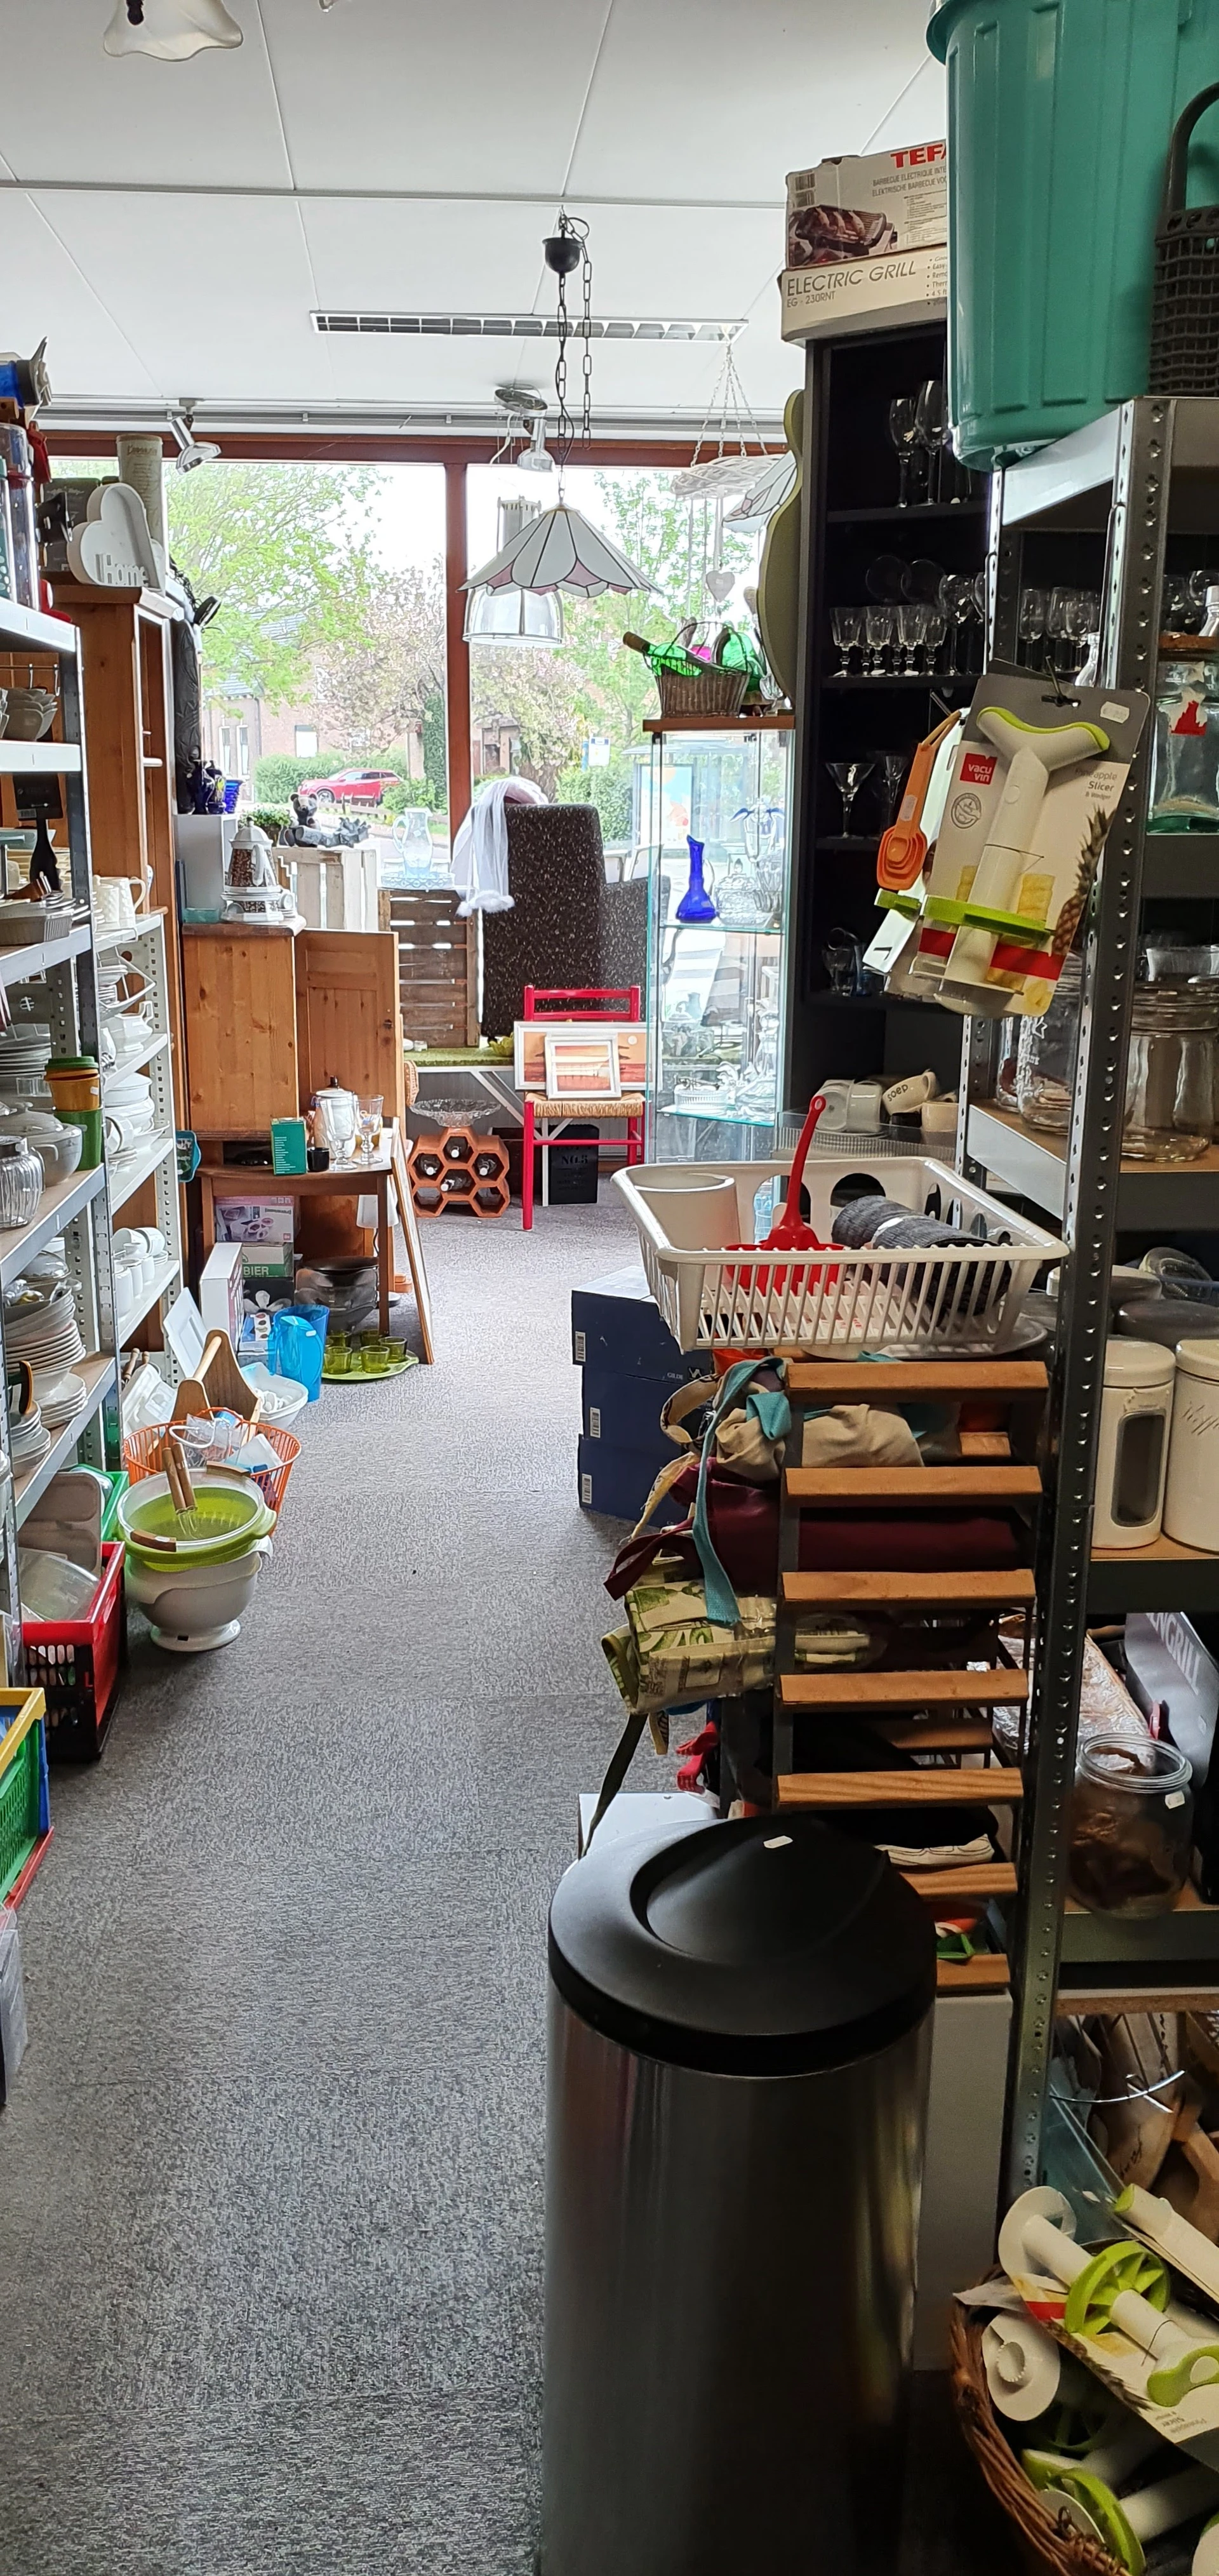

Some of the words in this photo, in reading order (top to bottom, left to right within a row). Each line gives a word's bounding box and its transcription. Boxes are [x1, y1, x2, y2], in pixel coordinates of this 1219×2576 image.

[787, 269, 863, 297] ELECTRIC
[869, 260, 916, 282] GRILL
[787, 297, 798, 308] EG
[805, 290, 836, 305] 230RNT
[968, 763, 992, 774] vacu
[974, 773, 990, 782] vin
[1088, 780, 1114, 792] Slicer
[887, 1084, 909, 1102] soep
[243, 1266, 269, 1276] BIER
